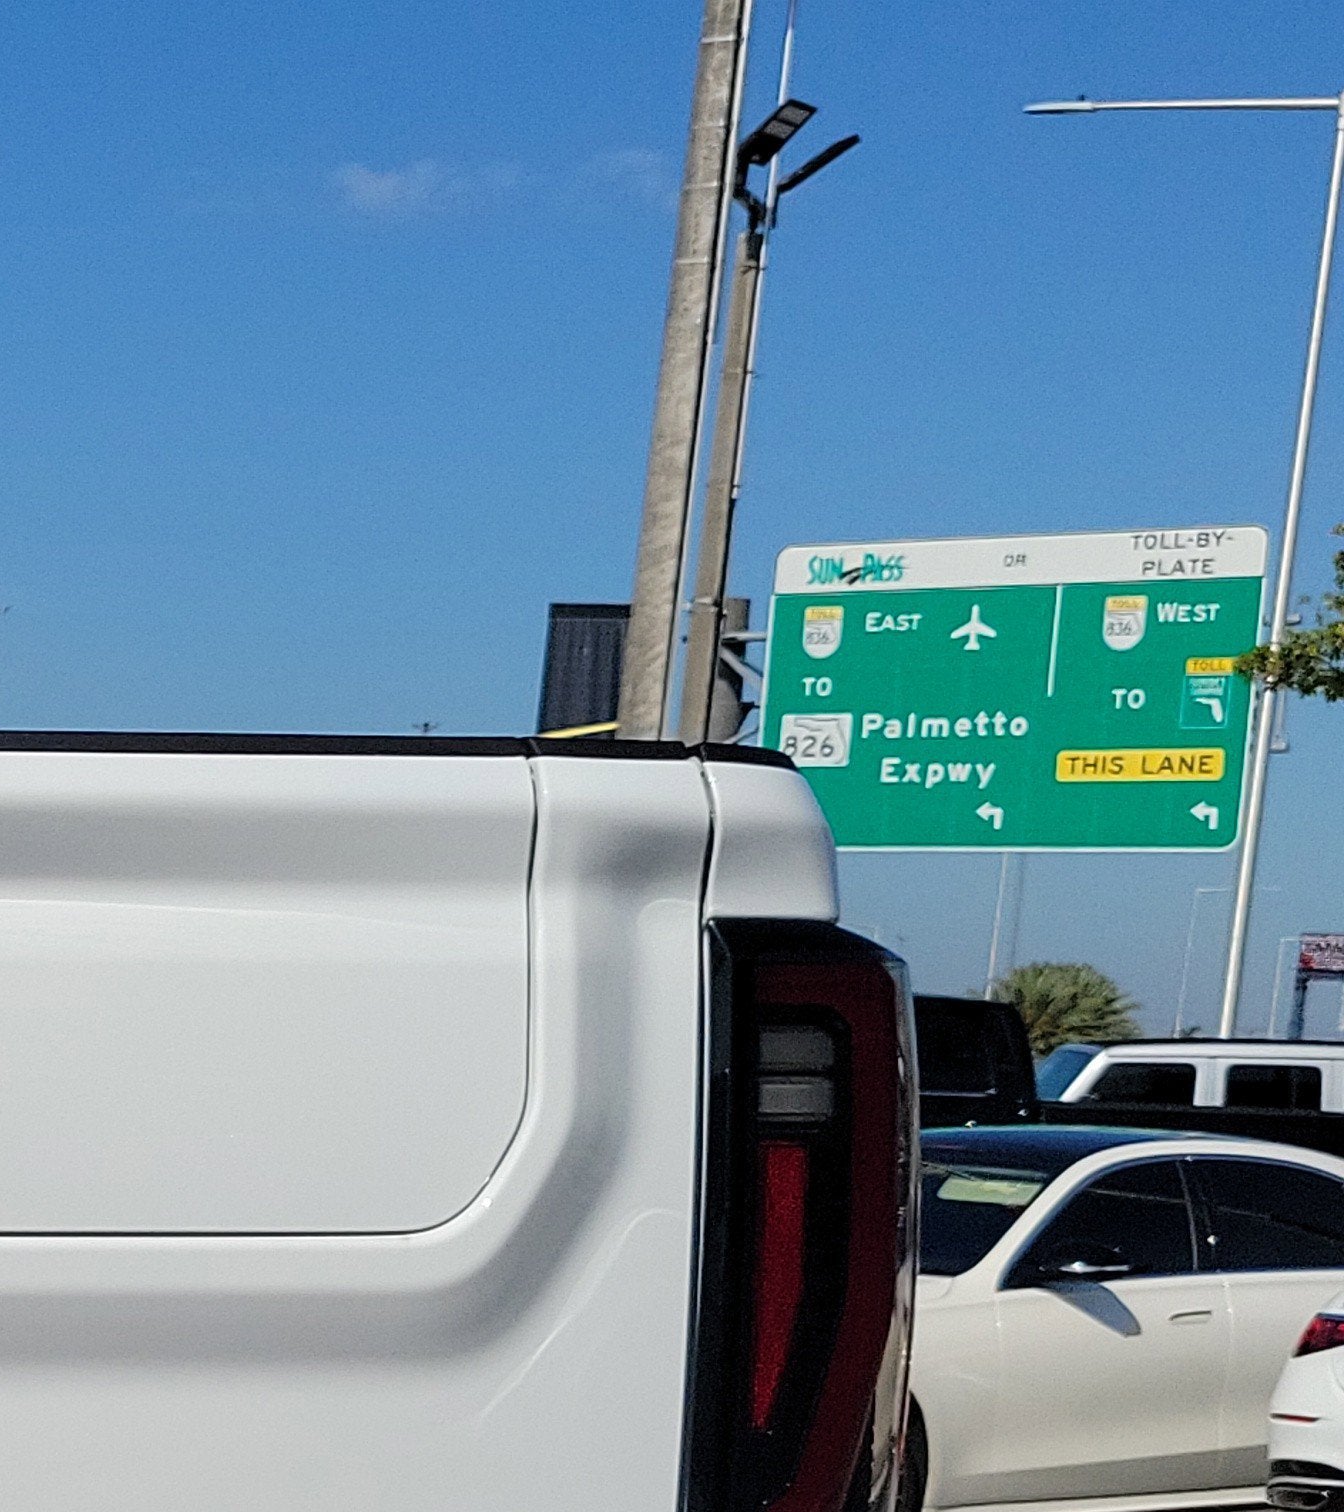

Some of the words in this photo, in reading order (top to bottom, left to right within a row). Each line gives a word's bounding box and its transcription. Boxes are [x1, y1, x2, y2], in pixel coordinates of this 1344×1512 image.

[1141, 558, 1216, 576] PLATE
[865, 612, 923, 632] EAST
[1157, 602, 1221, 622] WEST
[1192, 659, 1226, 671] TOLL
[802, 678, 833, 697] TO
[1112, 688, 1146, 709] TO
[862, 711, 1029, 739] Palmetto
[783, 736, 834, 757] 826
[880, 757, 997, 789] Expwy
[1065, 757, 1124, 775] THIS
[1142, 755, 1214, 775] LANE
